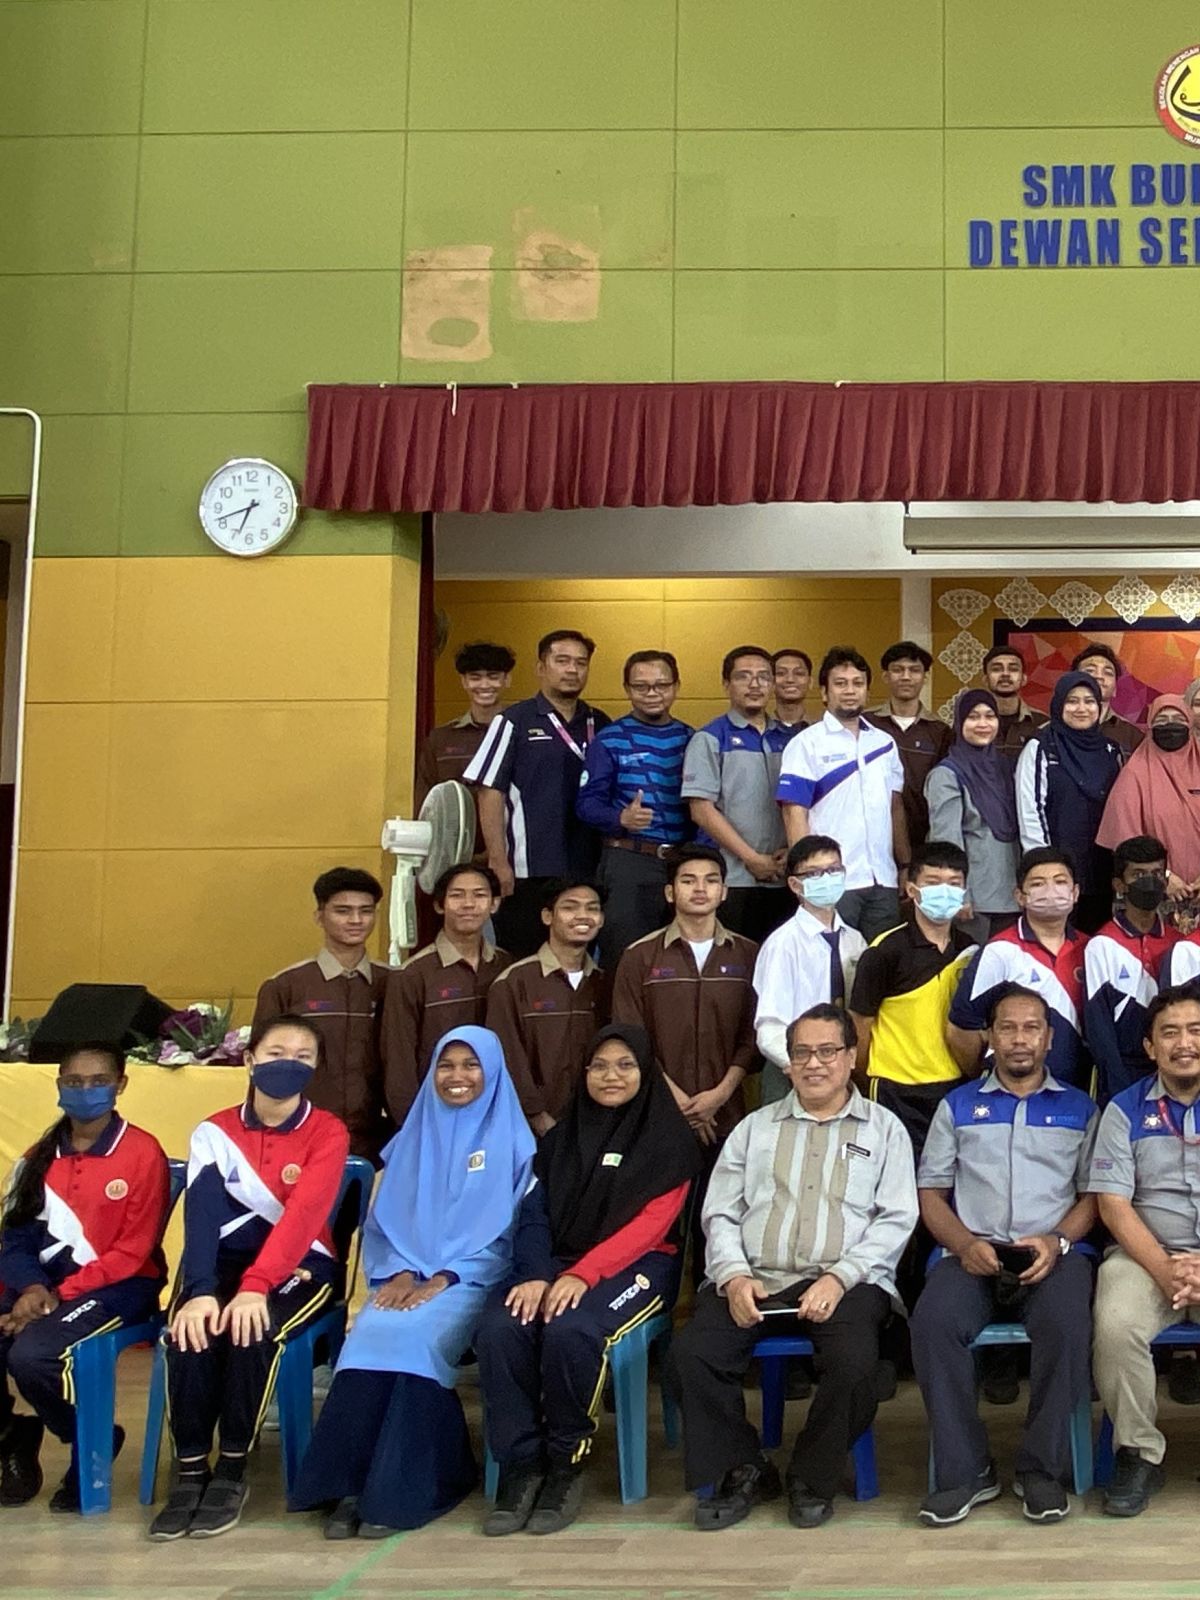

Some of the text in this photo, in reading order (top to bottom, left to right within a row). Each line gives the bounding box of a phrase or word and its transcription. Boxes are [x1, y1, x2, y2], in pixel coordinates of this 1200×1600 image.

[1022, 165, 1116, 207] SMK
[969, 218, 1120, 267] DEWAN
[232, 475, 242, 486] 11
[246, 470, 259, 482] 12
[267, 475, 271, 487] 1
[219, 486, 233, 499] 10
[274, 486, 284, 499] 2
[279, 502, 288, 514] 3
[218, 518, 227, 529] 8
[272, 517, 281, 528] 4
[230, 528, 240, 540] 7
[244, 533, 254, 545] 6
[260, 529, 269, 541] 5
